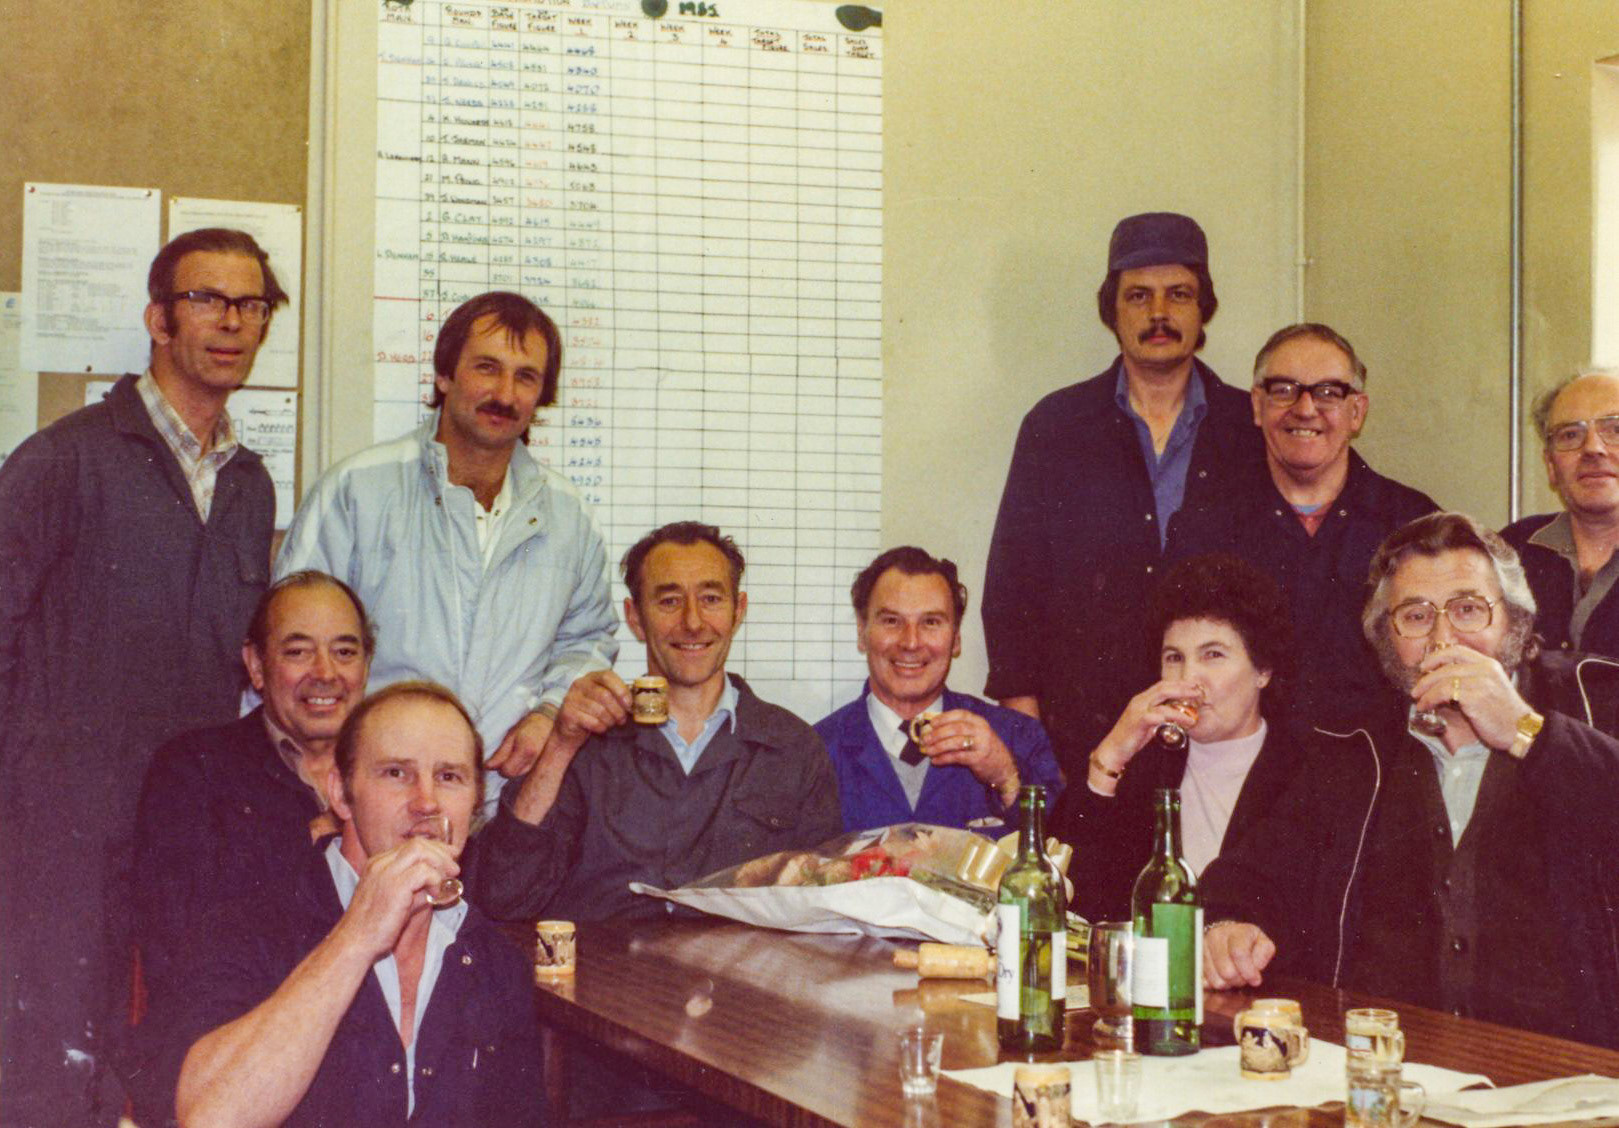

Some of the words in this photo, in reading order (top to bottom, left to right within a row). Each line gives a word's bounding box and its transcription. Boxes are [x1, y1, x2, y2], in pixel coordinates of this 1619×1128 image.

[568, 18, 592, 26] WEEK
[661, 24, 685, 32] WEEK
[709, 27, 732, 35] WEEK
